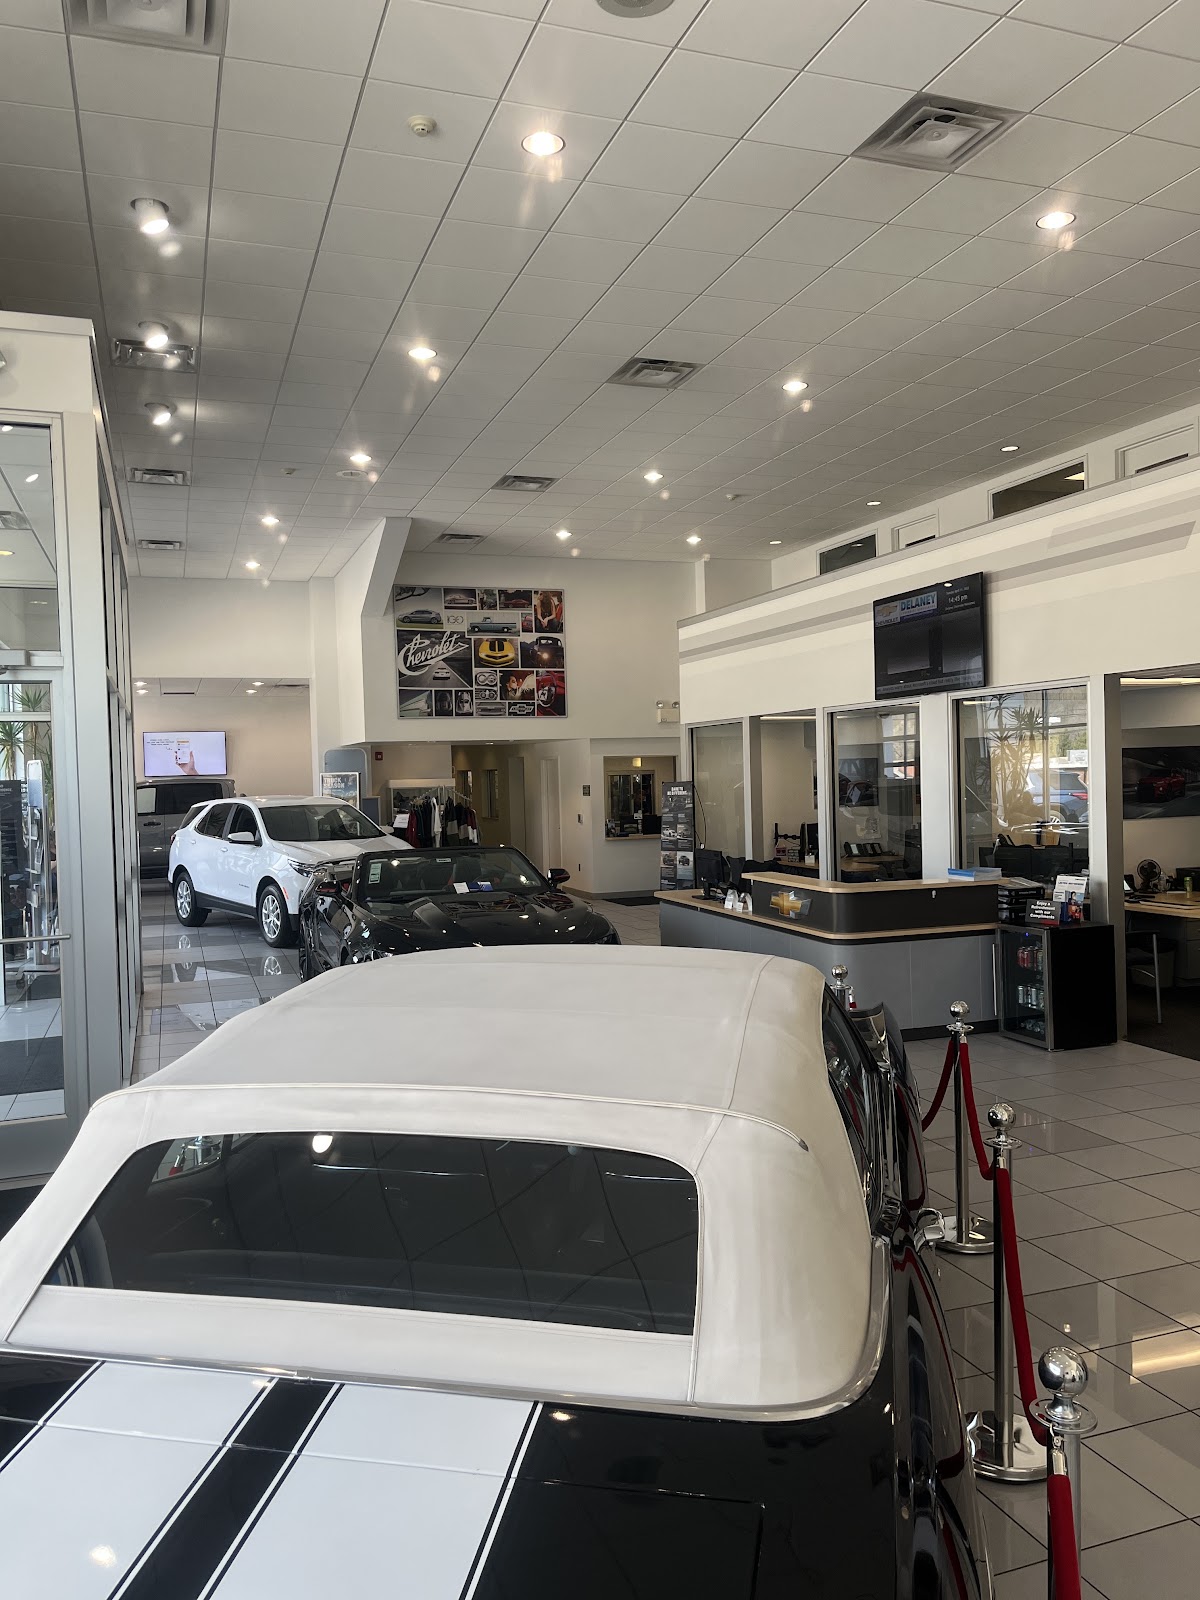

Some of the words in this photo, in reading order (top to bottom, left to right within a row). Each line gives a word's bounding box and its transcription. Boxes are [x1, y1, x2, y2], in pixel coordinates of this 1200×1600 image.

[900, 594, 936, 611] DELANEY
[875, 617, 899, 627] CHEVROLET
[398, 631, 469, 676] Chevrolet
